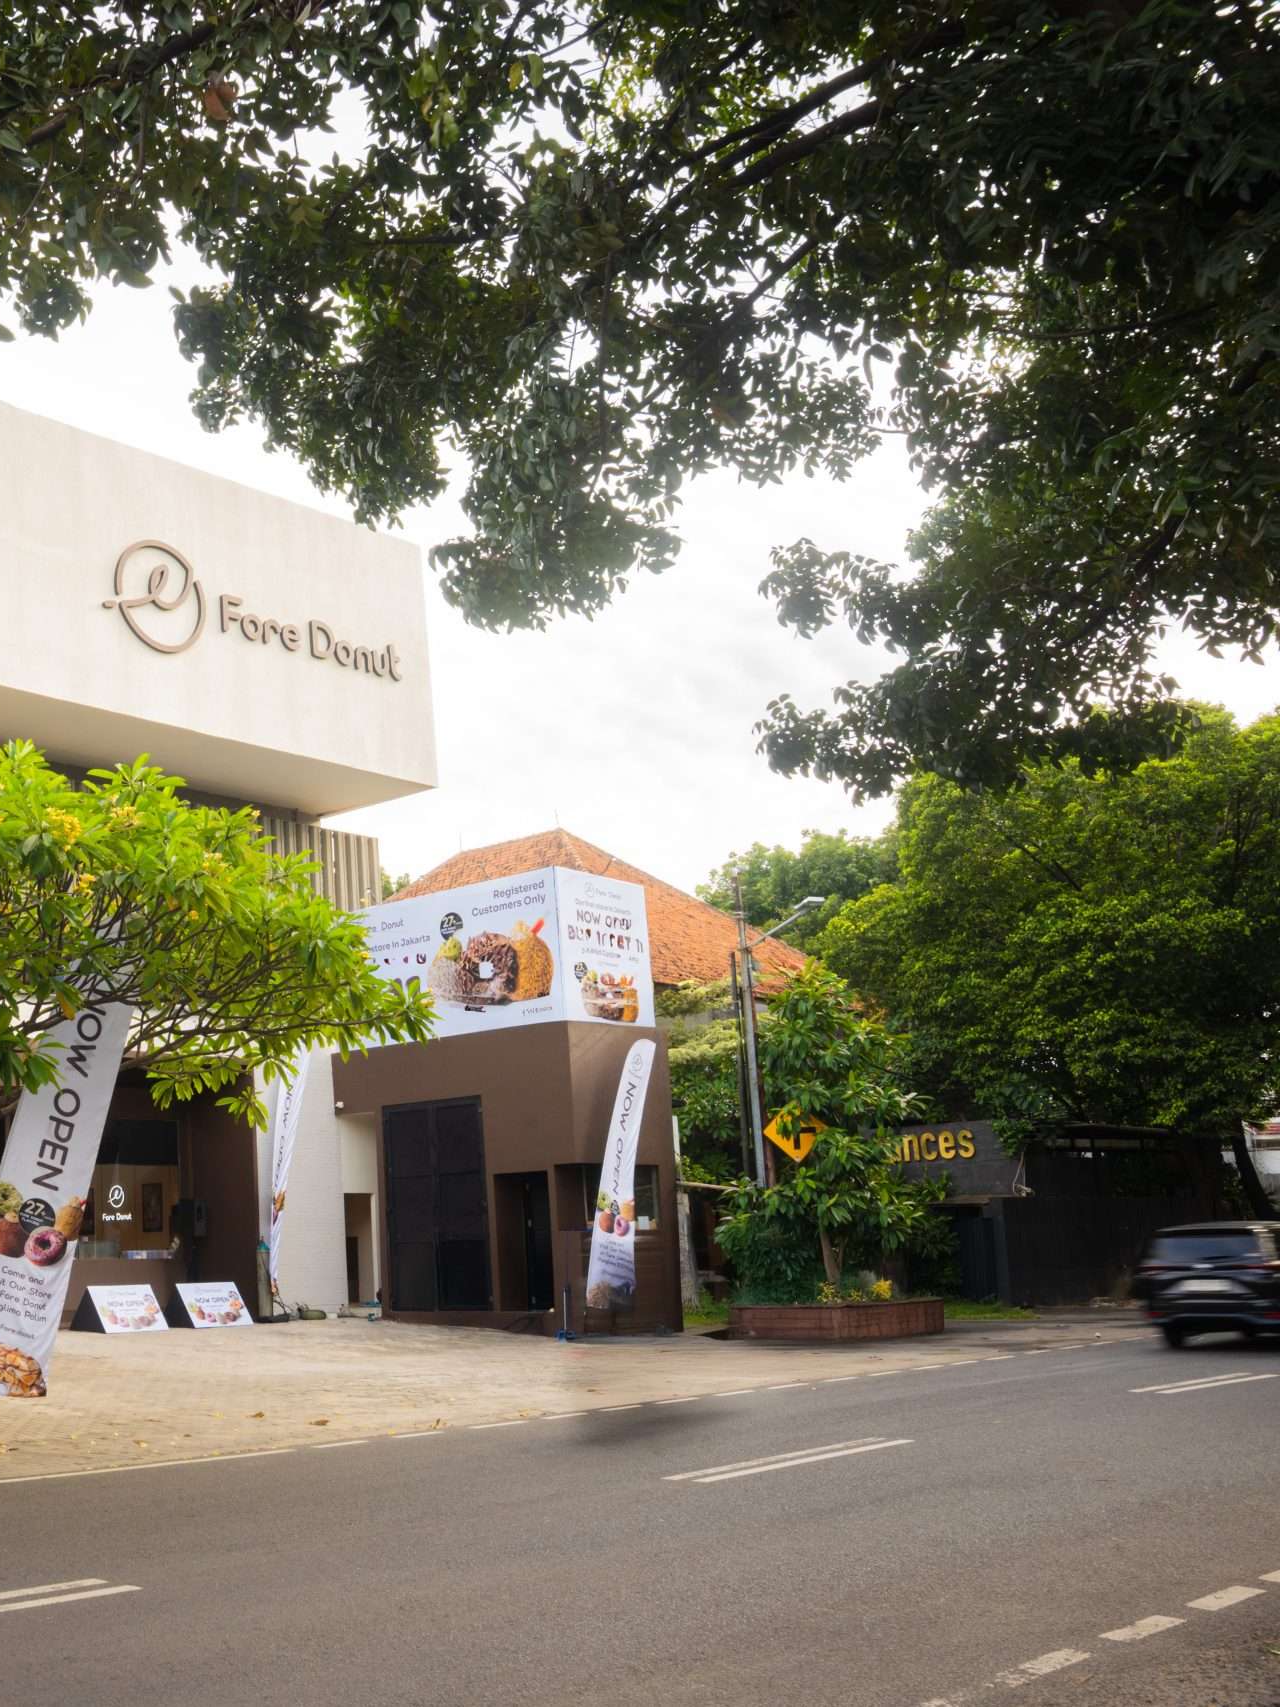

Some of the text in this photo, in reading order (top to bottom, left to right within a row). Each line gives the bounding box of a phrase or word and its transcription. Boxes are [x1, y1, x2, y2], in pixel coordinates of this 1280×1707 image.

[220, 594, 401, 682] Fore Donut
[493, 880, 545, 899] Registered
[471, 893, 546, 917] Customers Only
[381, 918, 404, 931] Donut
[576, 909, 601, 925] NOW
[400, 935, 431, 947] Jakarta
[620, 1081, 637, 1132] NOW
[32, 1087, 81, 1193] OPEN
[895, 1128, 976, 1162] nces
[612, 1137, 624, 1196] OPEN
[102, 1211, 132, 1221] Fore Donut
[1, 1265, 44, 1286] Come and
[0, 1289, 20, 1303] Fore
[23, 1298, 47, 1311] Donut
[9, 1280, 26, 1292] Our
[28, 1287, 52, 1300] Store
[24, 1310, 47, 1324] Polim
